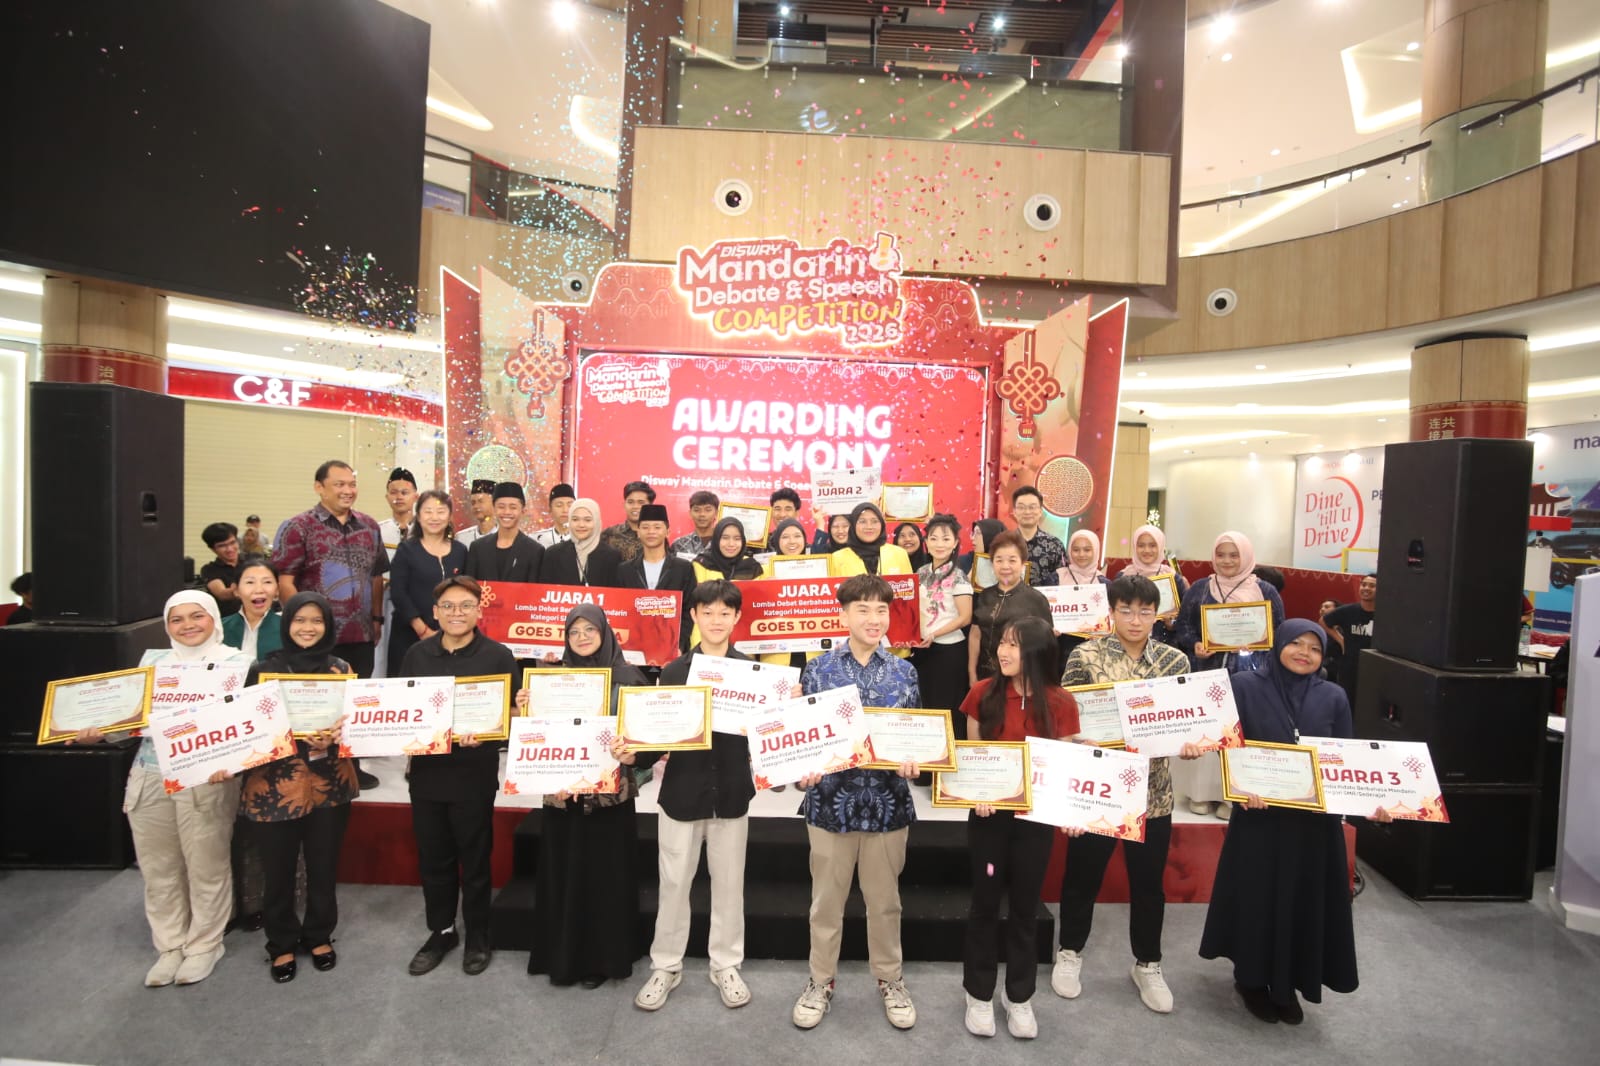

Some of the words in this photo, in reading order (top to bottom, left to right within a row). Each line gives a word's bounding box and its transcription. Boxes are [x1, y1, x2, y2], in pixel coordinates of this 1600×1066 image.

[720, 243, 783, 258] DISWAY
[685, 246, 867, 285] Mandarin
[696, 283, 780, 307] Debate
[785, 279, 803, 300] &
[808, 274, 894, 301] Speech
[847, 322, 899, 341] 2026
[588, 366, 657, 383] Mandarin
[233, 375, 312, 406] C&F
[672, 398, 892, 439] AWARDING
[672, 435, 891, 473] CEREMONY
[641, 474, 680, 488] Disway
[681, 476, 732, 488] Mandarin
[734, 477, 773, 490] Debate
[775, 478, 782, 490] &
[784, 479, 811, 491] Spee
[817, 486, 853, 497] JUARA
[855, 486, 862, 495] 2
[1305, 491, 1344, 513] Dine
[1304, 525, 1349, 548] Drive
[541, 590, 594, 605] JUARA
[597, 593, 604, 606] 1
[777, 584, 832, 598] JUARA
[515, 604, 538, 612] Lomba
[539, 605, 558, 613] Debat
[603, 609, 627, 617] ndarin
[1081, 603, 1088, 612] 3
[530, 613, 559, 622] Kategori
[515, 625, 553, 637] GOES
[558, 626, 565, 638] T
[757, 621, 795, 633] GOES
[799, 620, 817, 631] TO
[152, 692, 206, 703] HARAPAN
[712, 687, 756, 703] RAPAN
[758, 694, 767, 705] 2
[1084, 696, 1116, 705] CERTIFICAT
[351, 709, 409, 725] JUARA
[413, 708, 423, 722] 2
[1128, 707, 1195, 725] HARAPAN
[1197, 706, 1207, 717] 1
[169, 725, 238, 759] JUARA
[242, 720, 255, 735] 3
[760, 727, 820, 755] JUARA
[824, 723, 836, 739] 1
[516, 747, 575, 762] JUARA
[580, 747, 590, 760] 1
[1387, 771, 1401, 786] 3
[1099, 782, 1112, 799] 2
